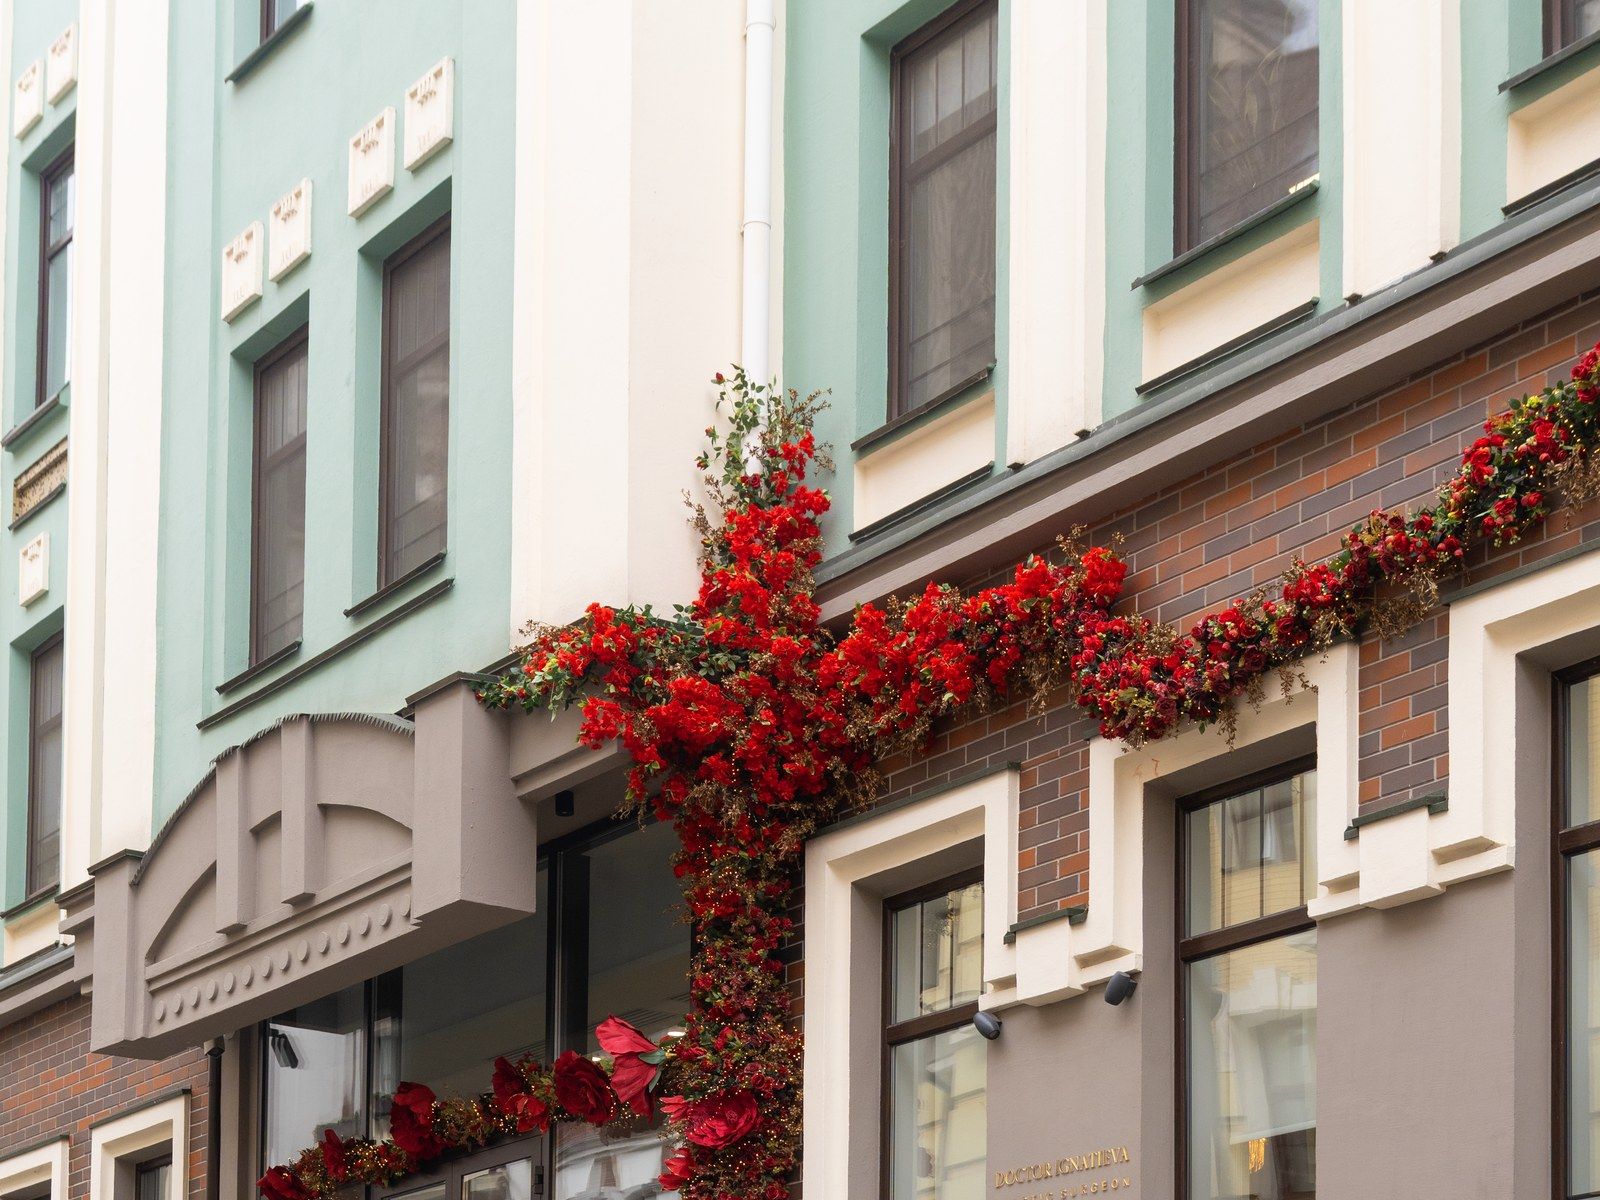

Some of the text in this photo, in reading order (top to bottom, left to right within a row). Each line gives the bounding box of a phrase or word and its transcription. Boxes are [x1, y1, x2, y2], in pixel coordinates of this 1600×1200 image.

[995, 1146, 1130, 1188] DOCTOR IGNATIEVA
[1060, 1176, 1131, 1200] SURGEON
